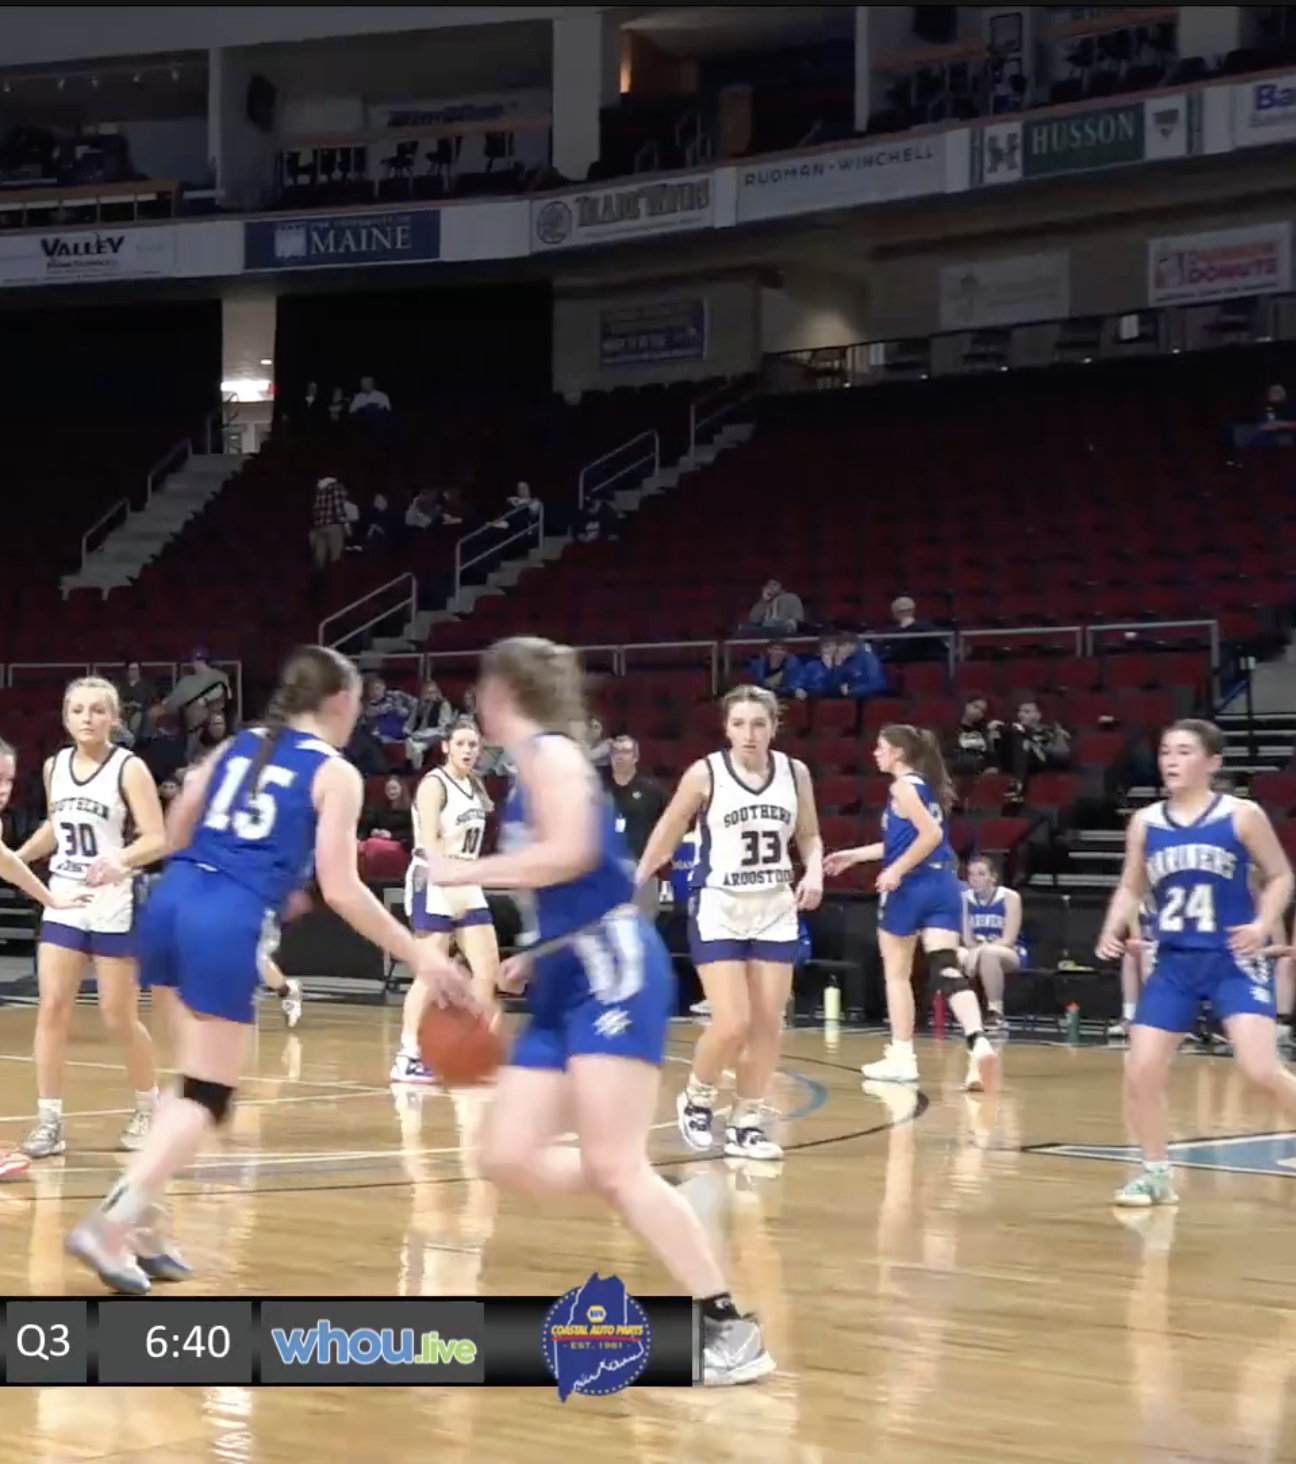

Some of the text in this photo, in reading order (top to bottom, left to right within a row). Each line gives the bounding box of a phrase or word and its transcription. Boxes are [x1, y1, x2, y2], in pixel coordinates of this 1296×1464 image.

[1031, 110, 1136, 154] HUSSON
[838, 146, 934, 172] WINCHELL
[41, 233, 126, 257] VALLEY
[310, 225, 413, 255] MAINE
[203, 756, 297, 841] 15
[723, 803, 792, 828] SOUTHERN
[59, 821, 99, 857] 30
[740, 830, 782, 867] 33
[1158, 883, 1217, 933] 24
